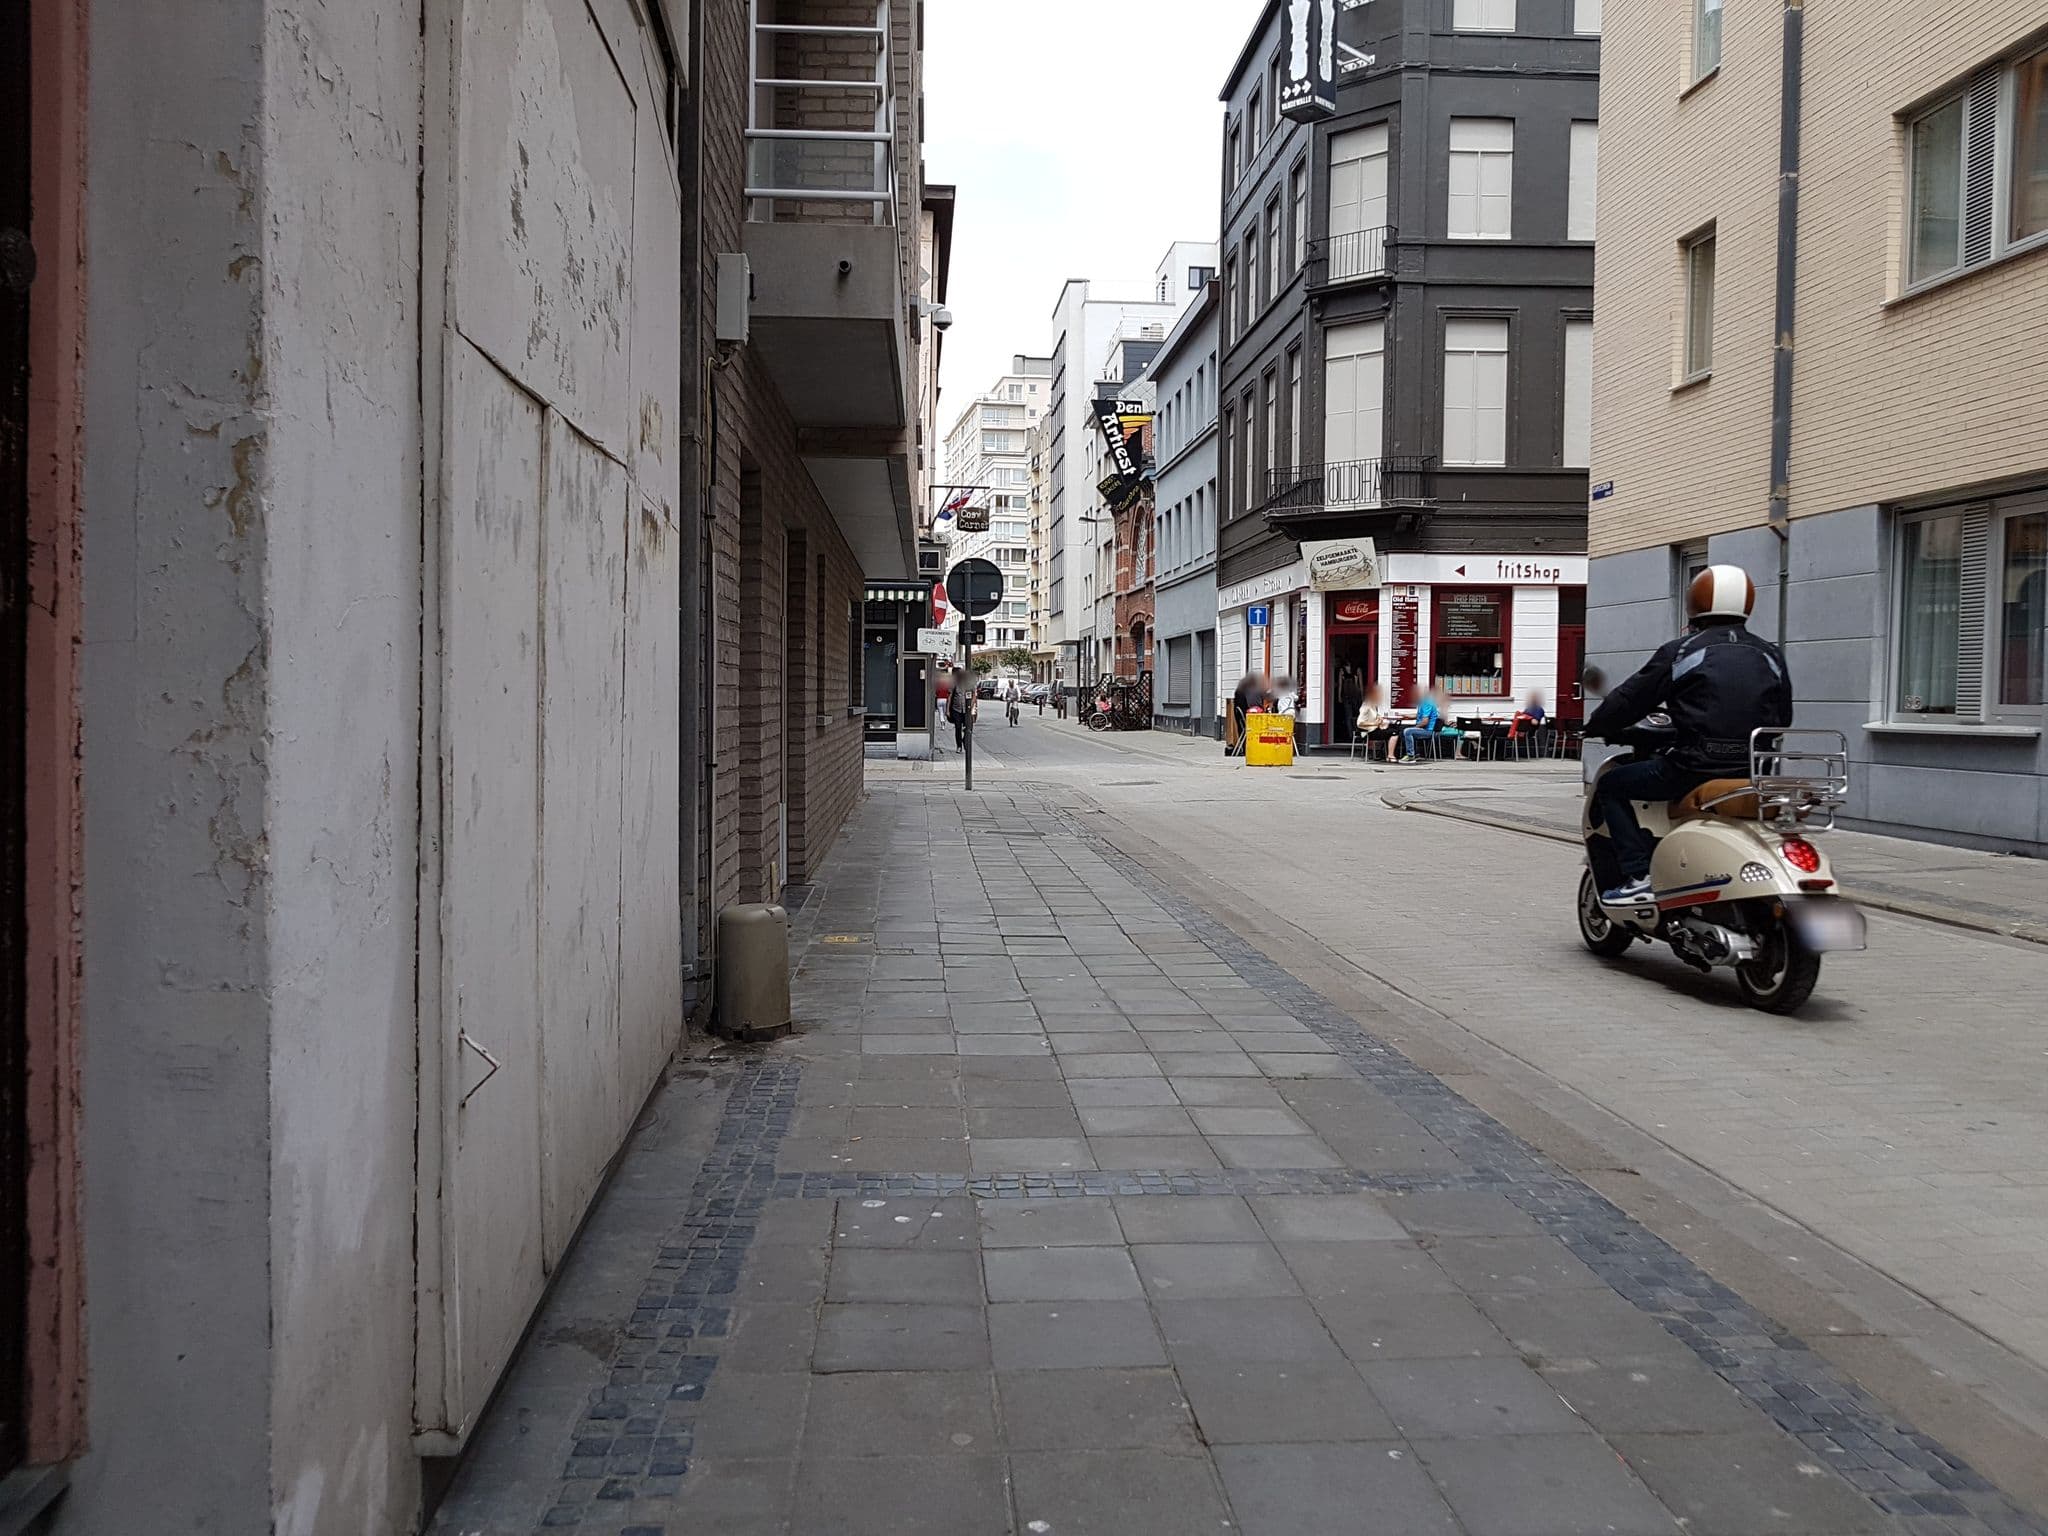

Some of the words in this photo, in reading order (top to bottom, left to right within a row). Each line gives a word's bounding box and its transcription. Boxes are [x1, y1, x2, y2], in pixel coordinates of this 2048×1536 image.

[1115, 401, 1142, 414] Den
[1101, 412, 1137, 476] Artiest
[1320, 554, 1358, 567] HAMBURGERS
